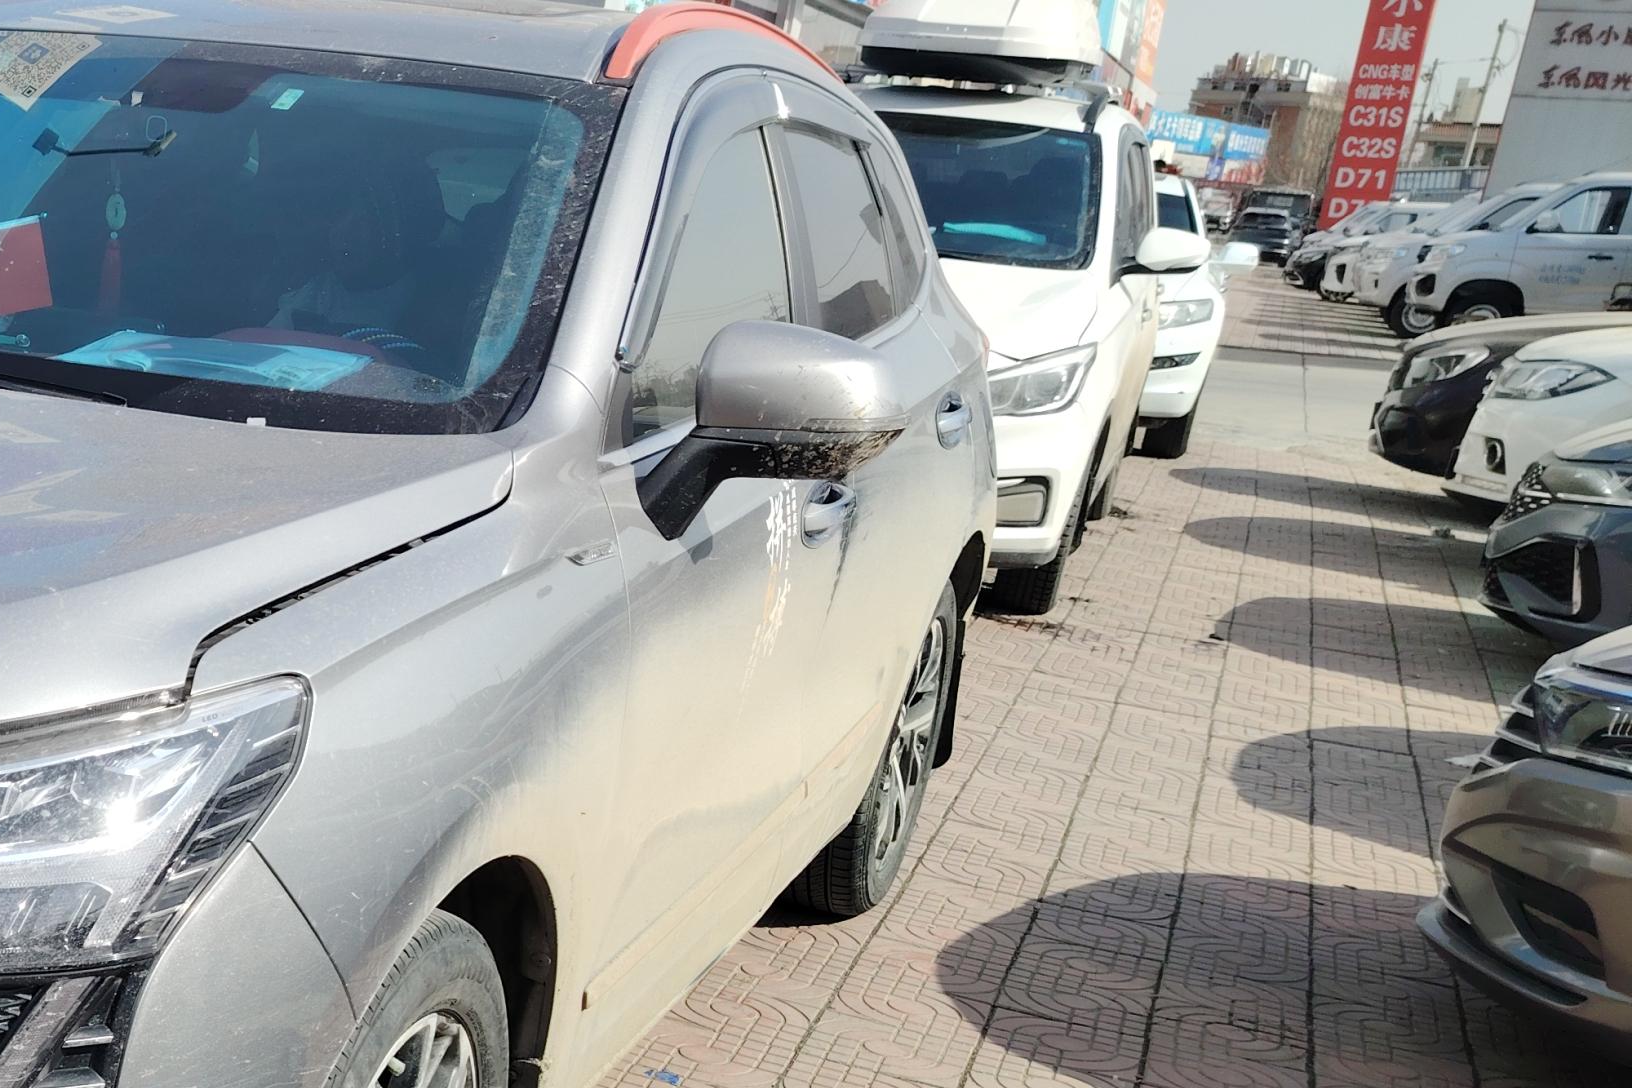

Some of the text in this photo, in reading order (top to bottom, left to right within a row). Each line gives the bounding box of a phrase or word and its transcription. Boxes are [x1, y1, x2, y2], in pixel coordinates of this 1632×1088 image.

[1349, 104, 1405, 128] C31S
[1341, 136, 1397, 159] C32S
[1334, 167, 1387, 189] D71
[1327, 197, 1366, 219] D7
